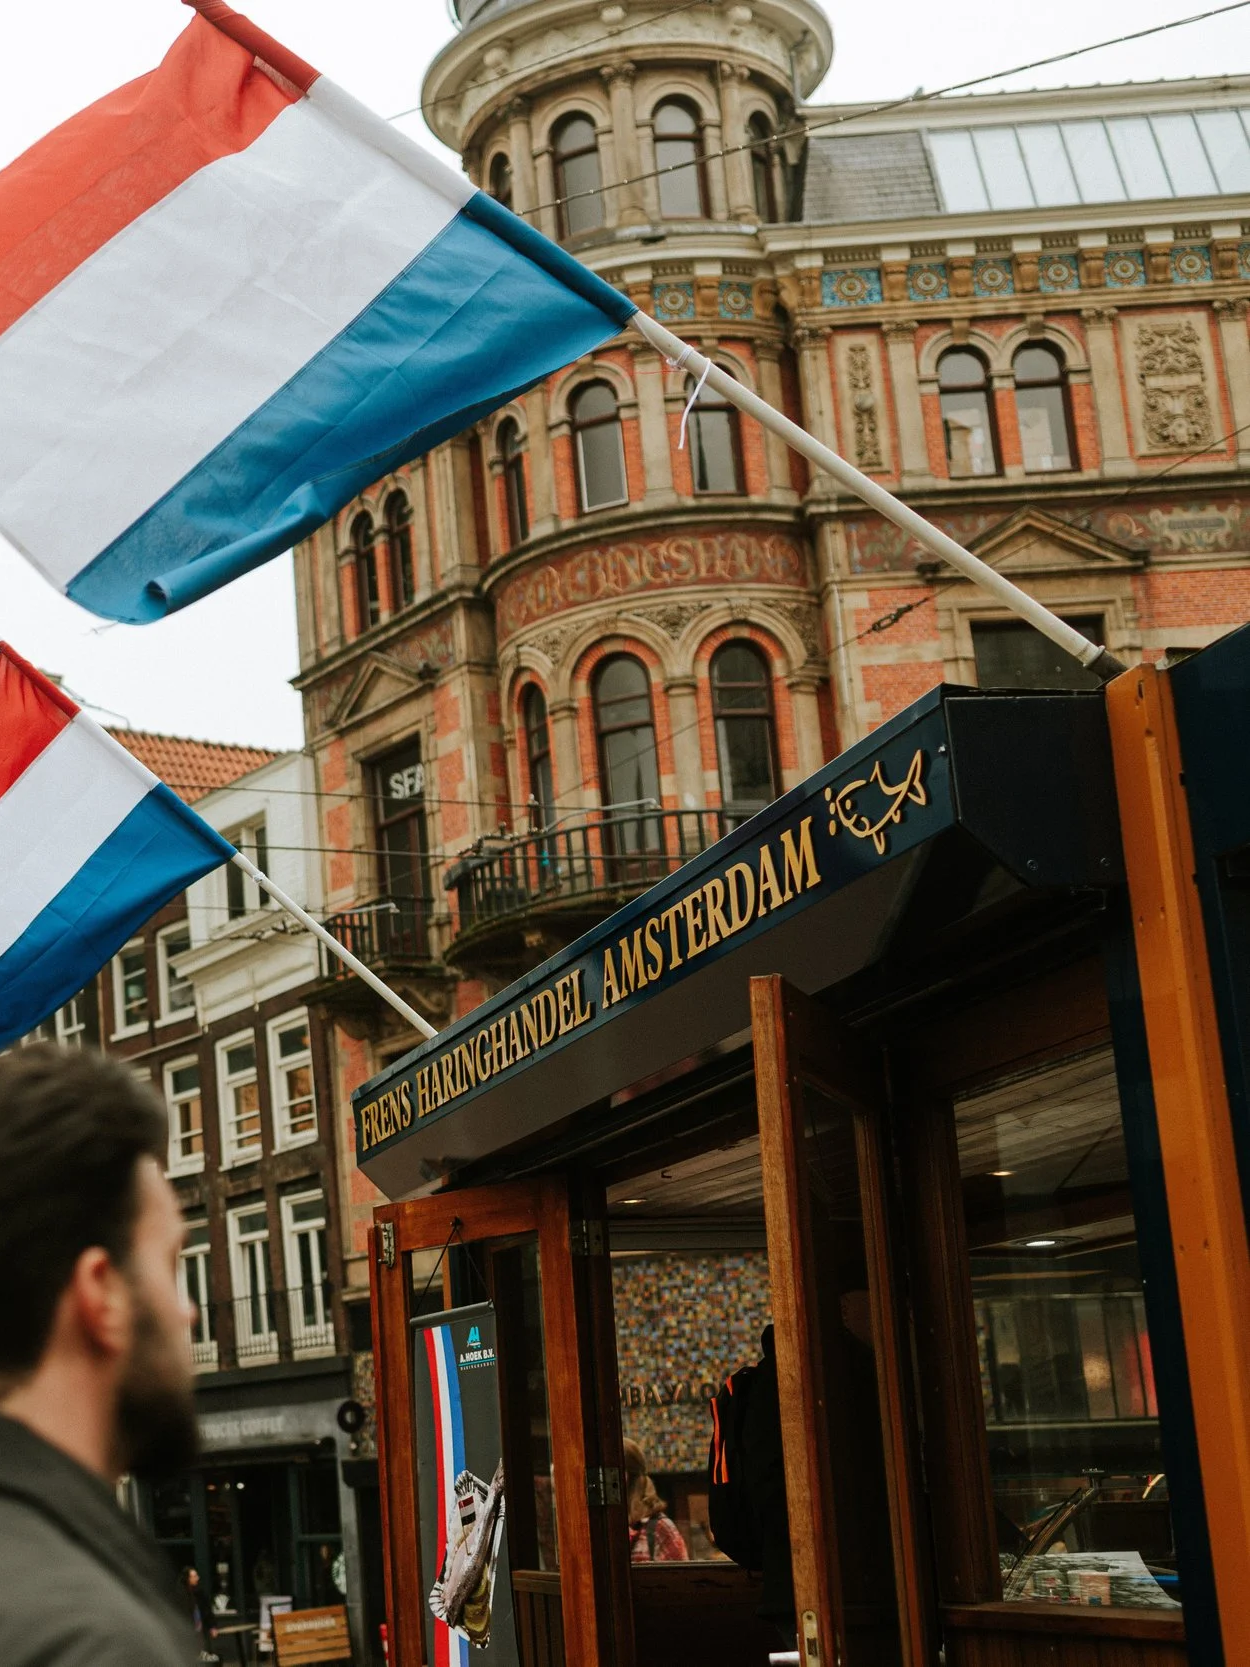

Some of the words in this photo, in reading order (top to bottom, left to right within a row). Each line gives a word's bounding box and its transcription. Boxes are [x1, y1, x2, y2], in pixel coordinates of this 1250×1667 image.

[360, 1080, 411, 1151] FRENS
[416, 968, 590, 1118] HARINGHANDEL
[602, 815, 822, 1010] AMSTERDAM
